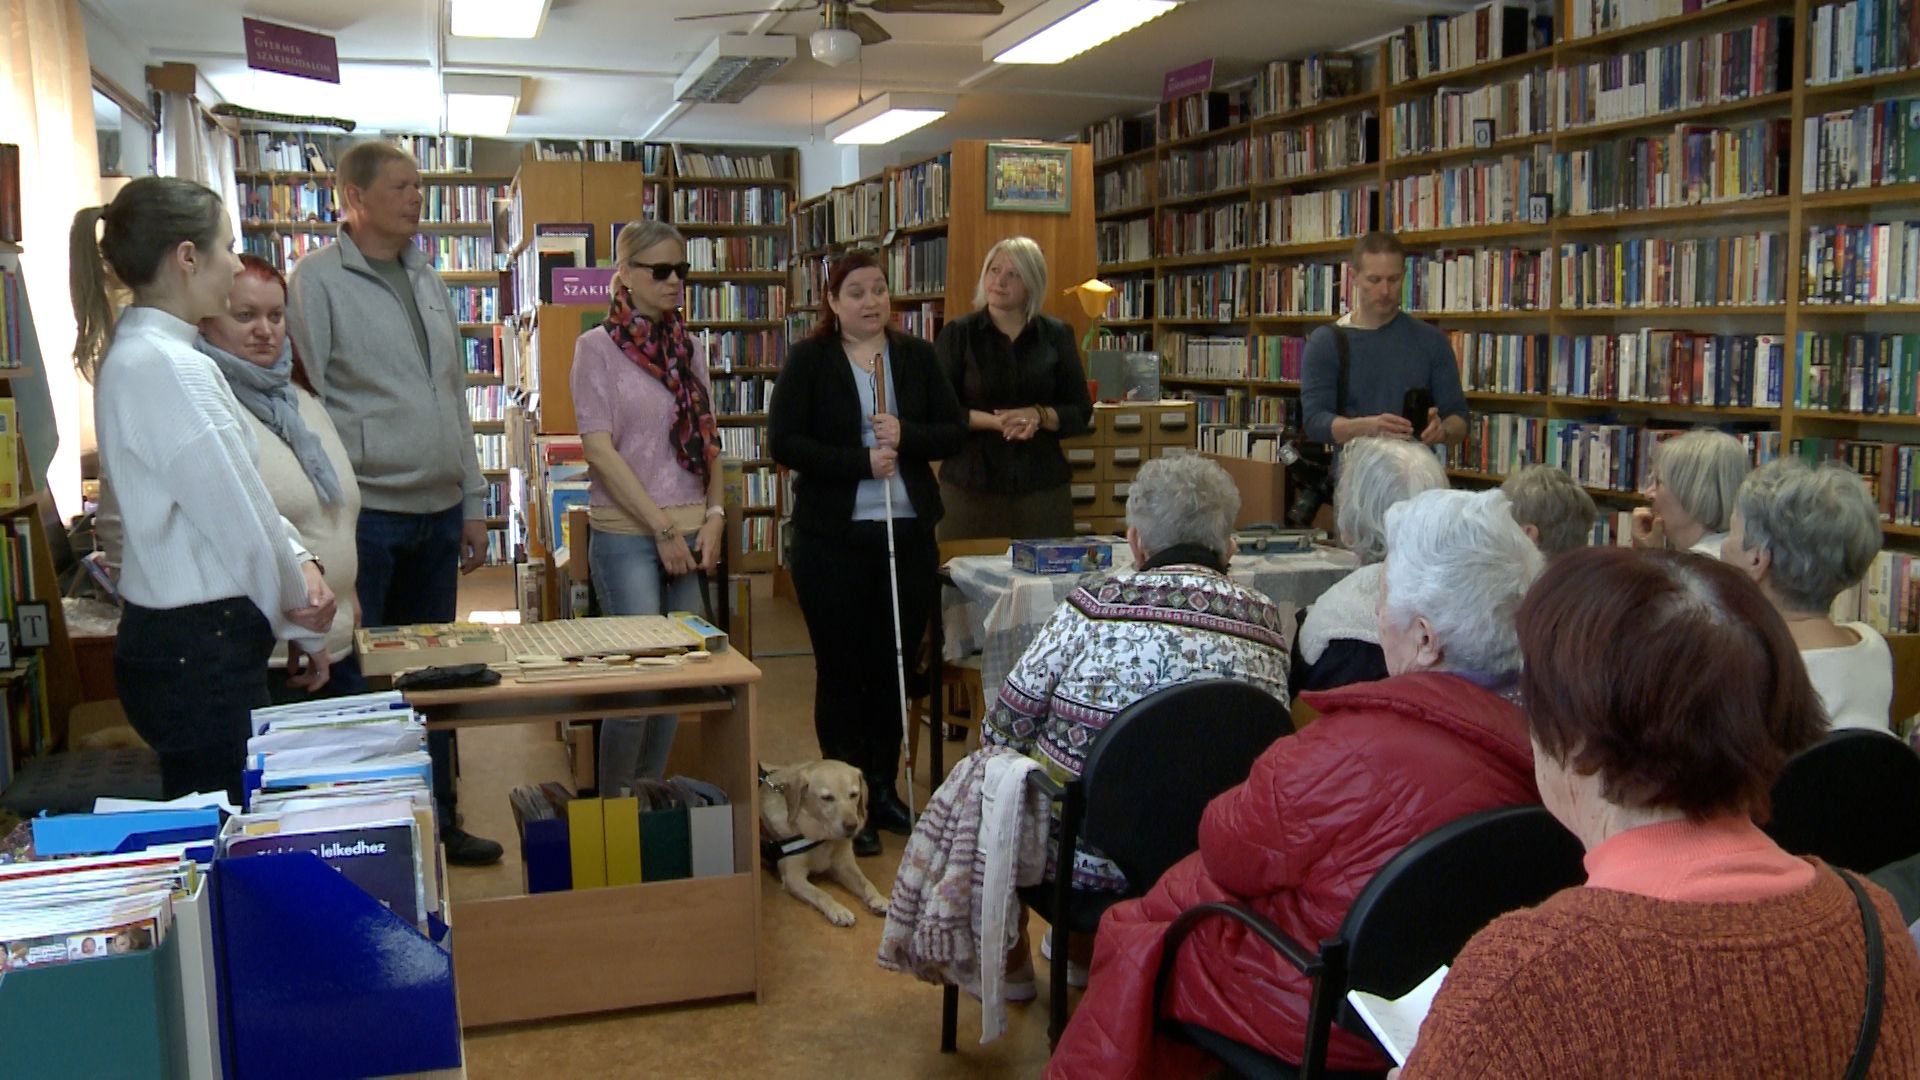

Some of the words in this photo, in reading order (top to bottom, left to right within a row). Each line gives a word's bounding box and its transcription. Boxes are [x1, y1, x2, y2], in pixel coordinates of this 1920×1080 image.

[254, 37, 302, 55] GYERMEK
[256, 51, 331, 73] SZAKIRODALOM
[1477, 128, 1488, 143] O
[1533, 203, 1543, 218] R
[23, 615, 42, 638] T
[320, 840, 387, 858] lelkedhez
